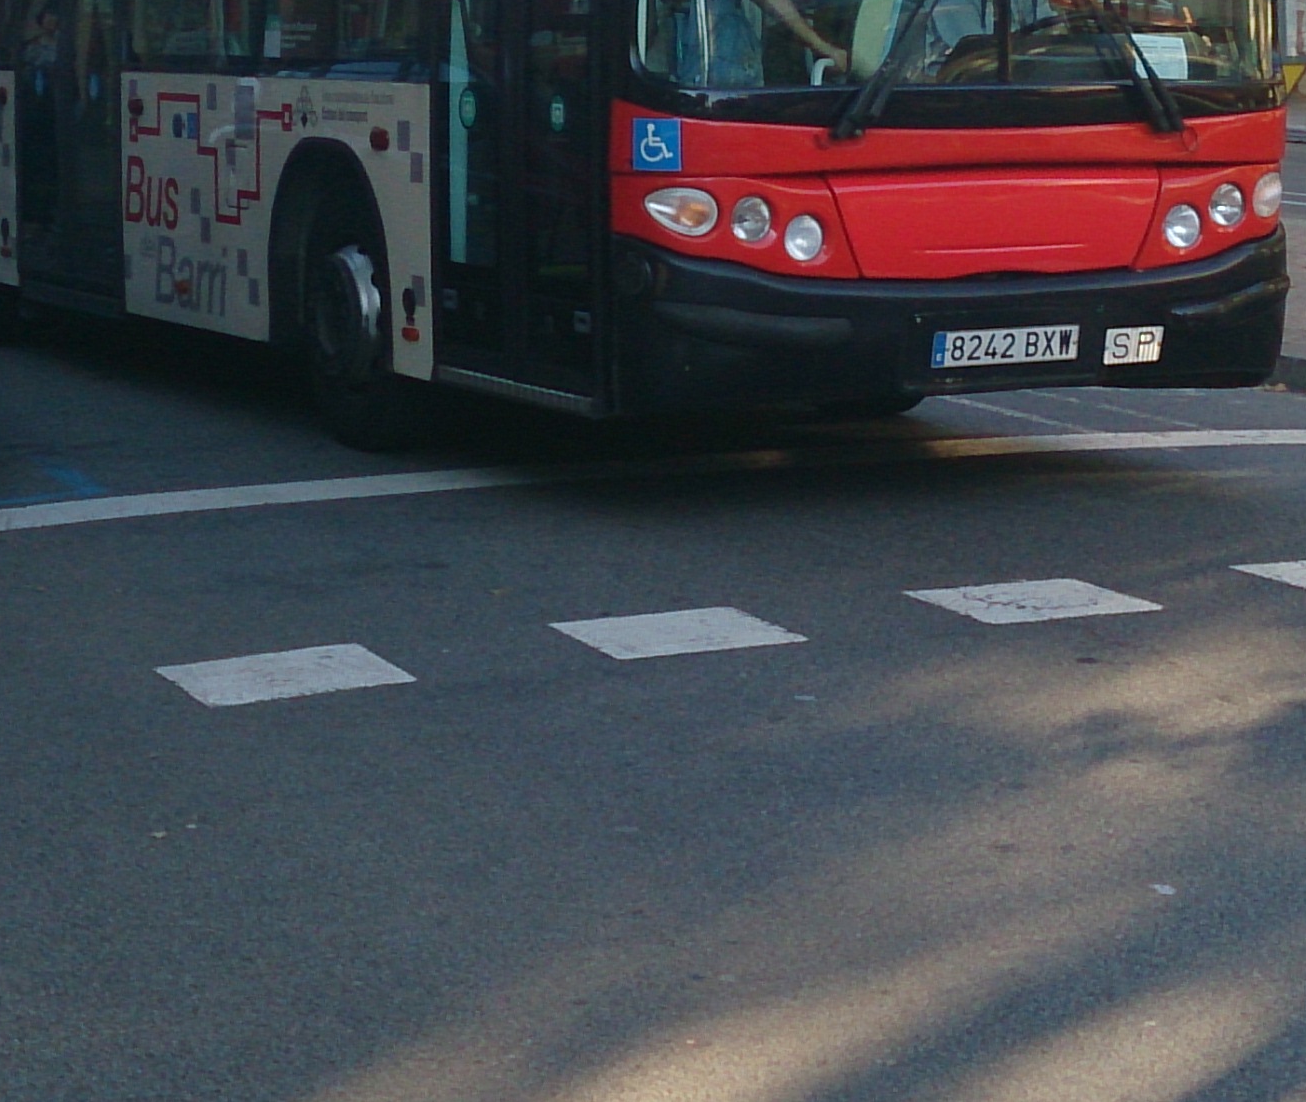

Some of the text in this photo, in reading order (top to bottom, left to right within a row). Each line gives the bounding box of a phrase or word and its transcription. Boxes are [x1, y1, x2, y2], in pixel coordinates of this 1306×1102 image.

[125, 155, 180, 230] Bus
[155, 235, 228, 318] Barri
[950, 332, 1016, 362] 8242
[1024, 328, 1073, 358] BXW
[1111, 331, 1156, 360] SP
